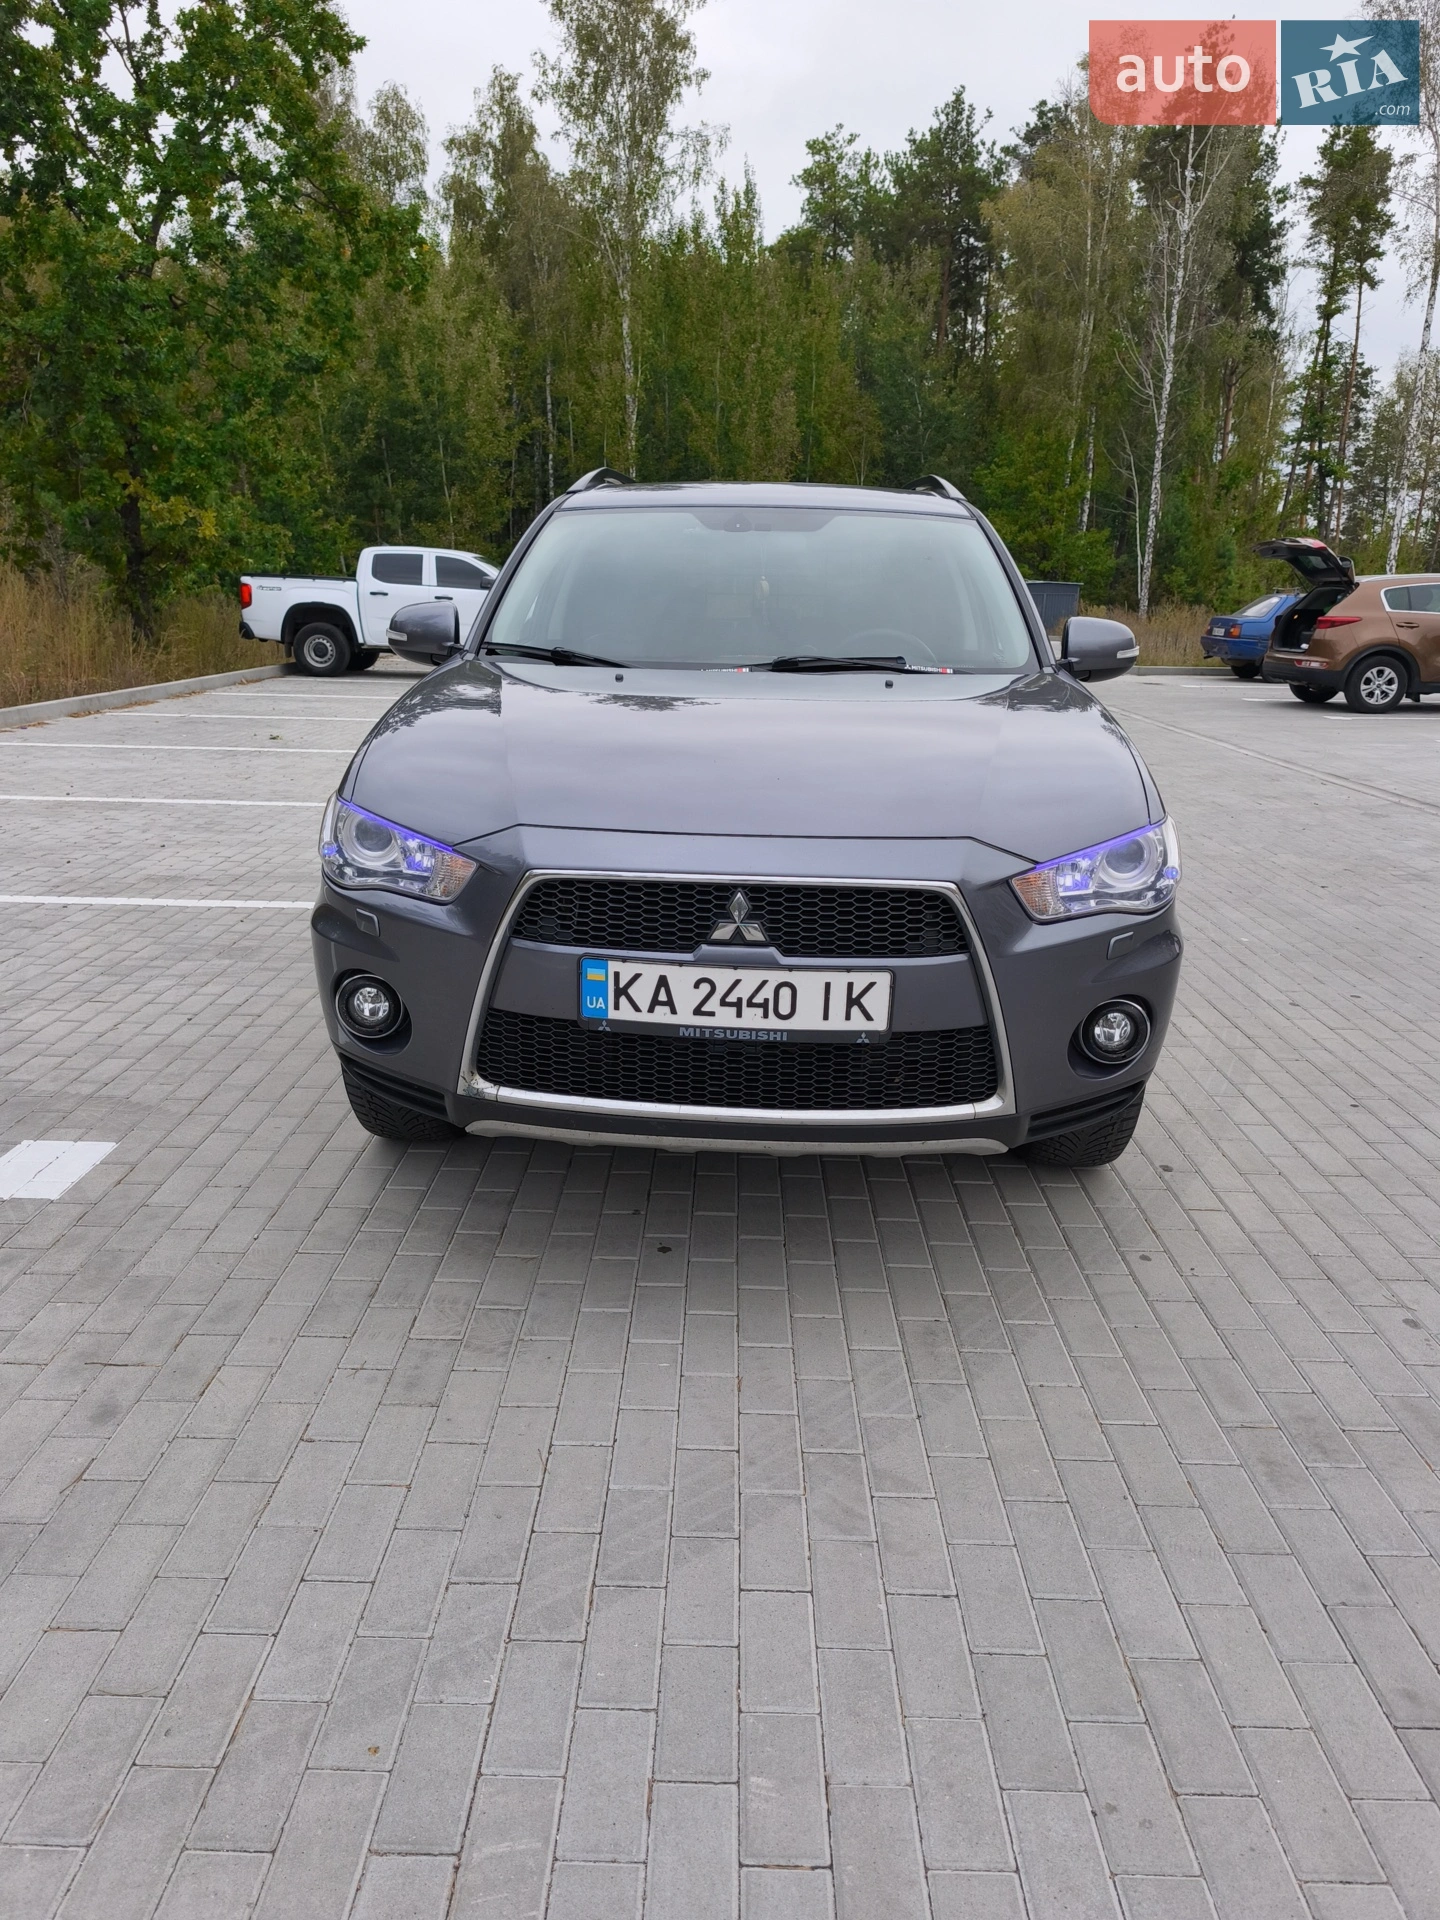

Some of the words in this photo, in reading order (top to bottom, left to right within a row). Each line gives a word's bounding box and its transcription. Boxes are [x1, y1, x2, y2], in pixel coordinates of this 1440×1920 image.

[586, 995, 606, 1010] UA
[613, 971, 678, 1015] KA
[692, 977, 798, 1021] 2440
[822, 981, 878, 1022] IK
[679, 1026, 788, 1041] MITSUBISHI
